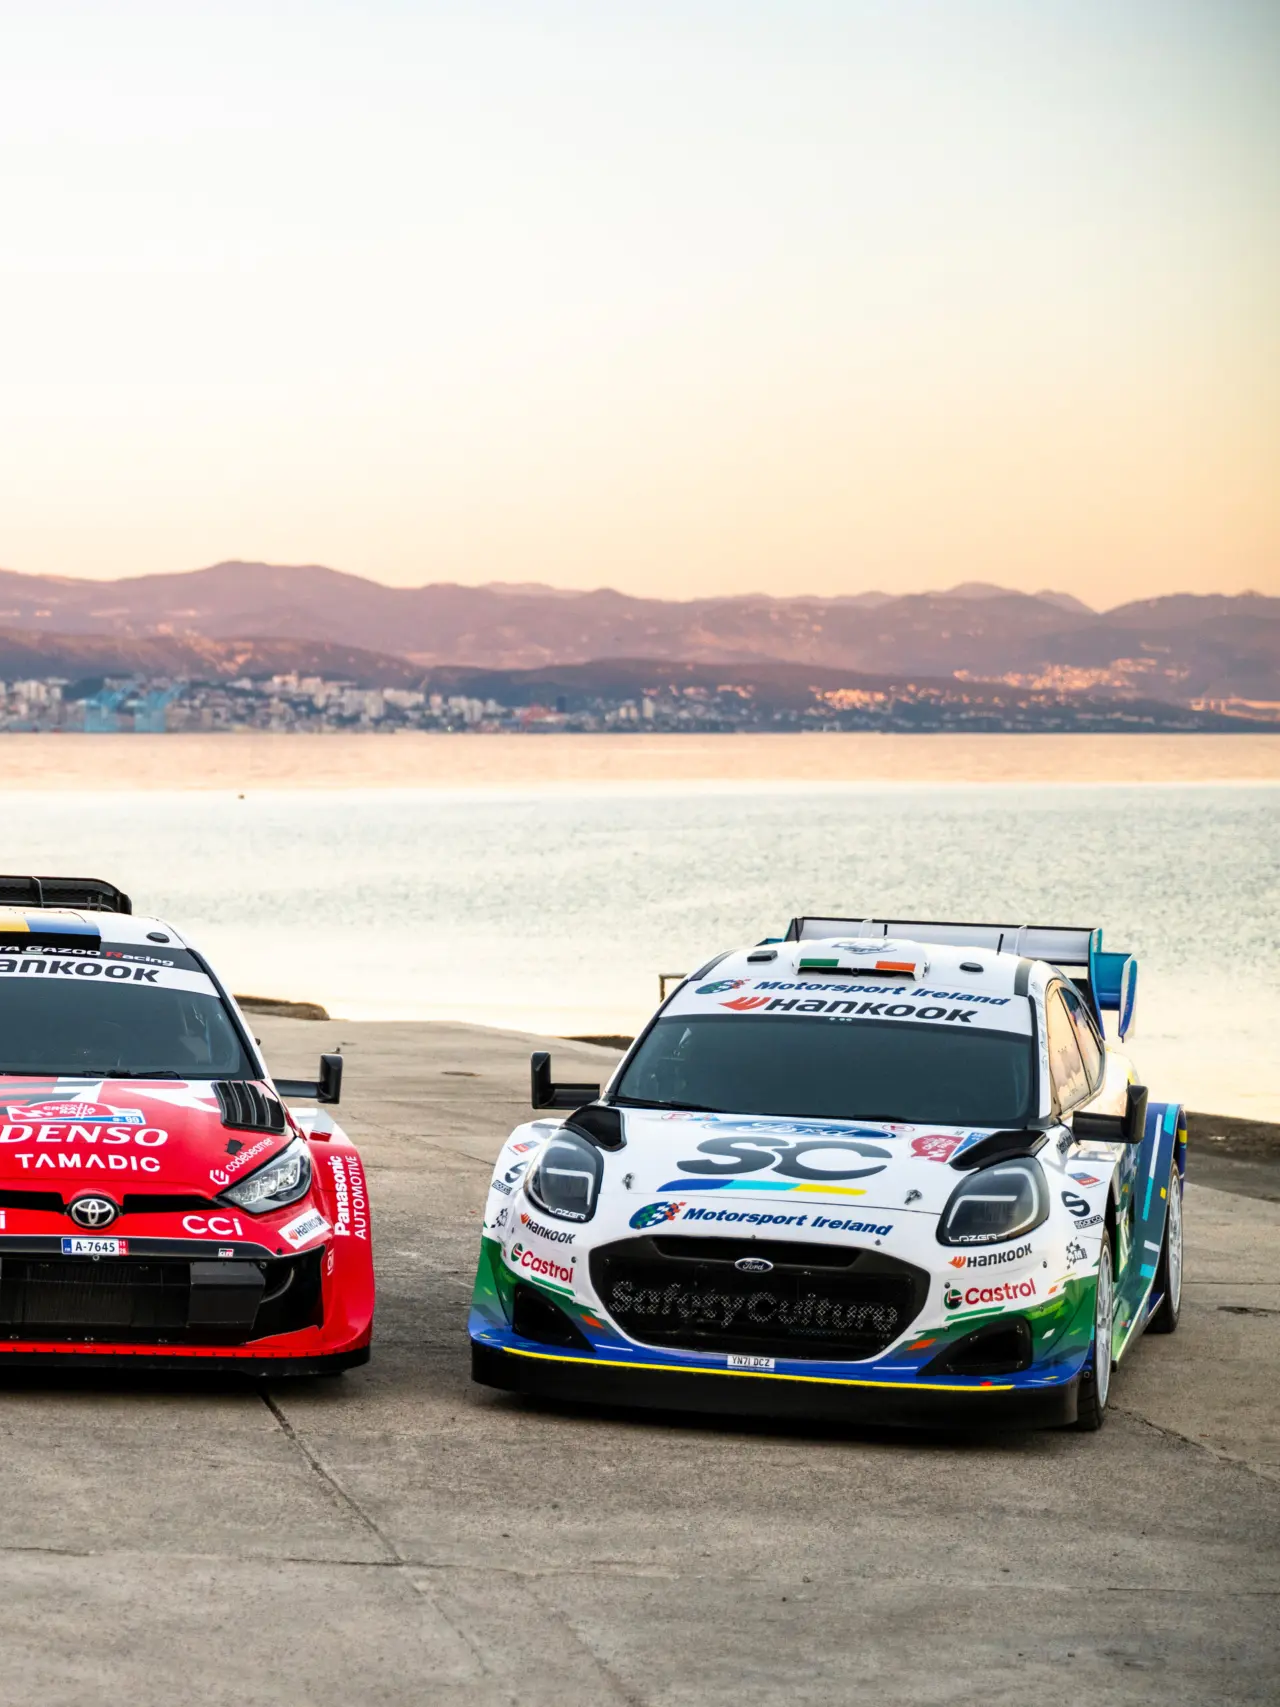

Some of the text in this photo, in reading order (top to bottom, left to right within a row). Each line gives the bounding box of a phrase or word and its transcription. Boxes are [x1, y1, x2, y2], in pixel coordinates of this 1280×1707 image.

[26, 945, 101, 956] GAZOO
[106, 951, 175, 967] Racing
[752, 981, 1012, 1006] Motorsport Ireland
[770, 999, 978, 1023] HANKOOK
[736, 1121, 861, 1137] Ford
[14, 1153, 161, 1172] TAMADIC
[225, 1137, 276, 1173] codebeamer
[676, 1136, 893, 1181] SC
[327, 1155, 351, 1236] Panasonic
[344, 1155, 367, 1240] AUTOMOTIVE
[526, 1218, 577, 1245] HANKOOK
[682, 1207, 894, 1237] Motorsport Ireland
[75, 1241, 116, 1253] A-7645
[966, 1243, 1033, 1268] HANKOOK
[521, 1250, 575, 1284] Castrol
[741, 1261, 765, 1271] Ford
[965, 1278, 1037, 1305] Castrol
[609, 1280, 898, 1332] SafetyCulture
[731, 1356, 770, 1366] YN71 DCZ
